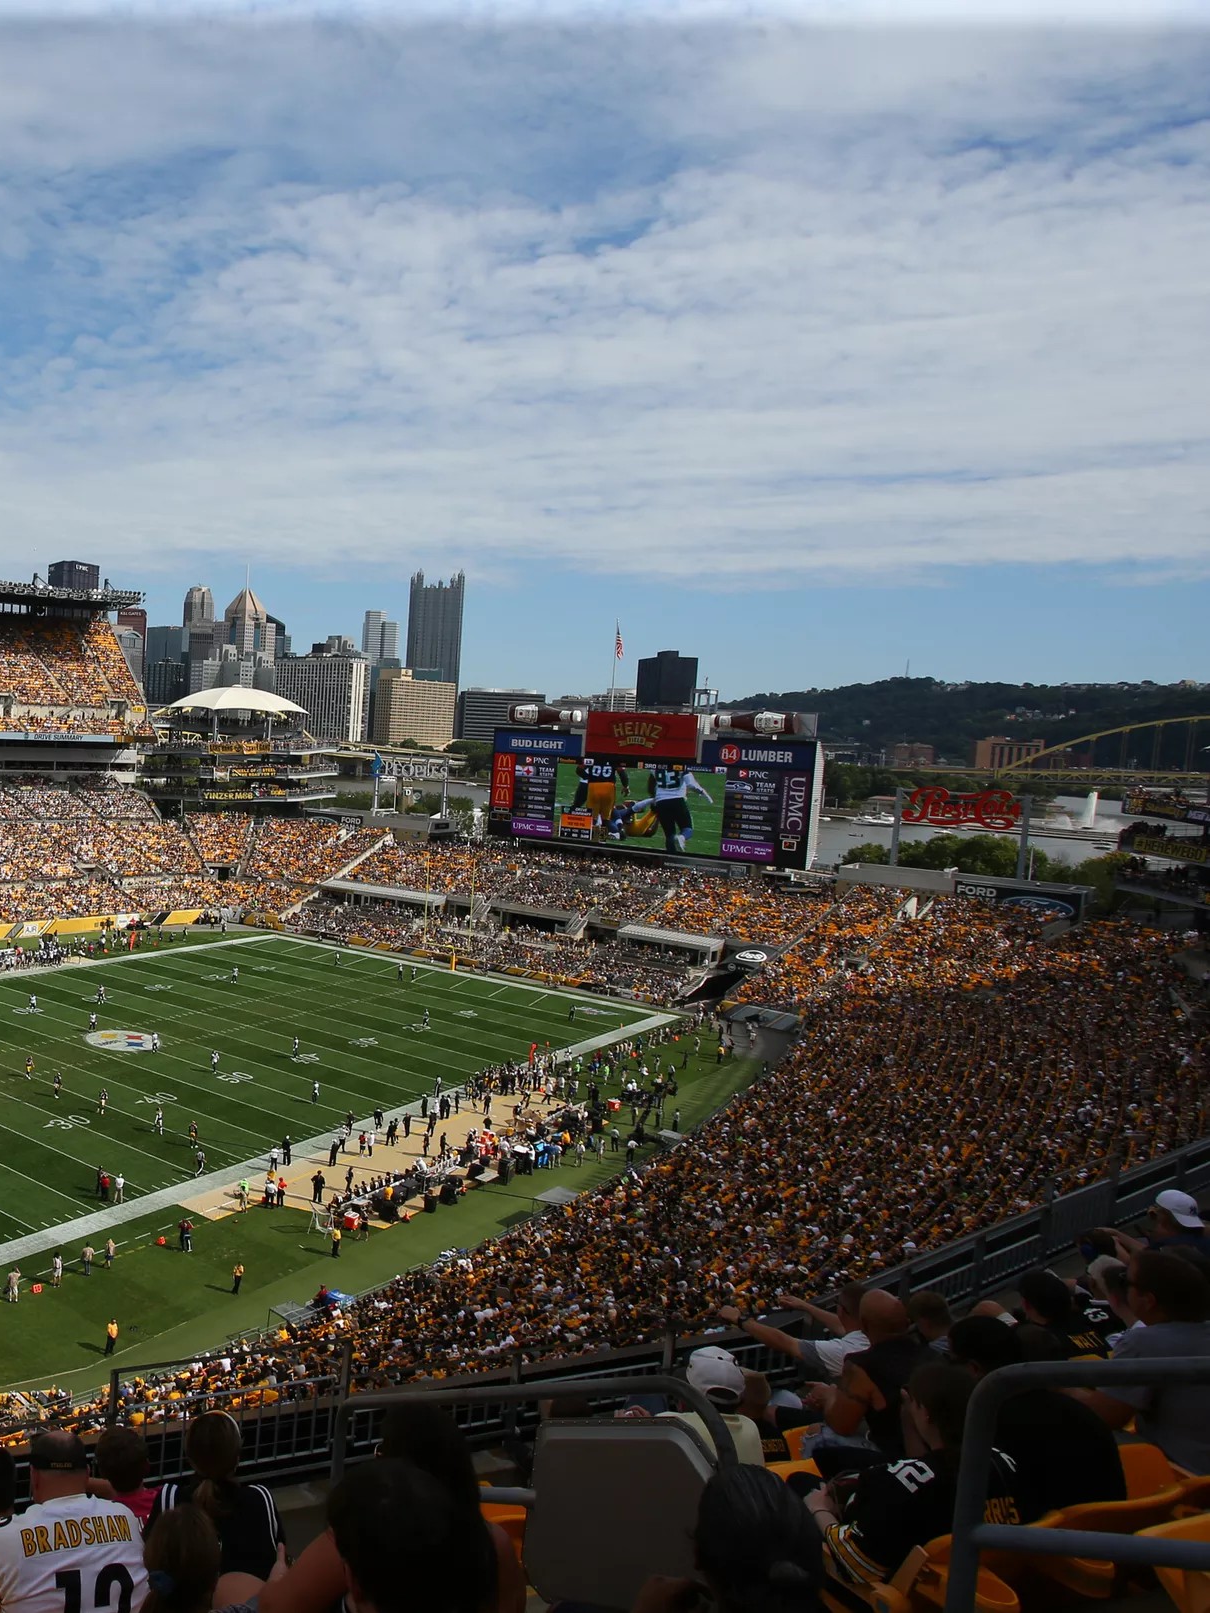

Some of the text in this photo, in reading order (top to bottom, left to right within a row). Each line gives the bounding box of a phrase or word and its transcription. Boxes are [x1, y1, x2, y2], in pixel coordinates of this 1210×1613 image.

[613, 721, 663, 739] HEINZ
[511, 738, 564, 750] BUD LIGHT
[533, 757, 550, 765] PNC
[721, 748, 793, 763] 84 LUMBER
[384, 760, 449, 779] PEOPLES
[748, 770, 769, 779] PNC
[756, 781, 776, 789] TEAM
[786, 776, 807, 831] UPMC
[341, 816, 362, 825] FORD
[512, 822, 535, 831] UPMC
[721, 843, 752, 854] UPMC
[1135, 839, 1204, 861] #HEREWEGO
[956, 884, 997, 898] FORD
[216, 1071, 254, 1084] 50
[143, 1091, 178, 1105] 40
[48, 1114, 90, 1130] 30
[20, 1513, 133, 1558] BRADSHAW
